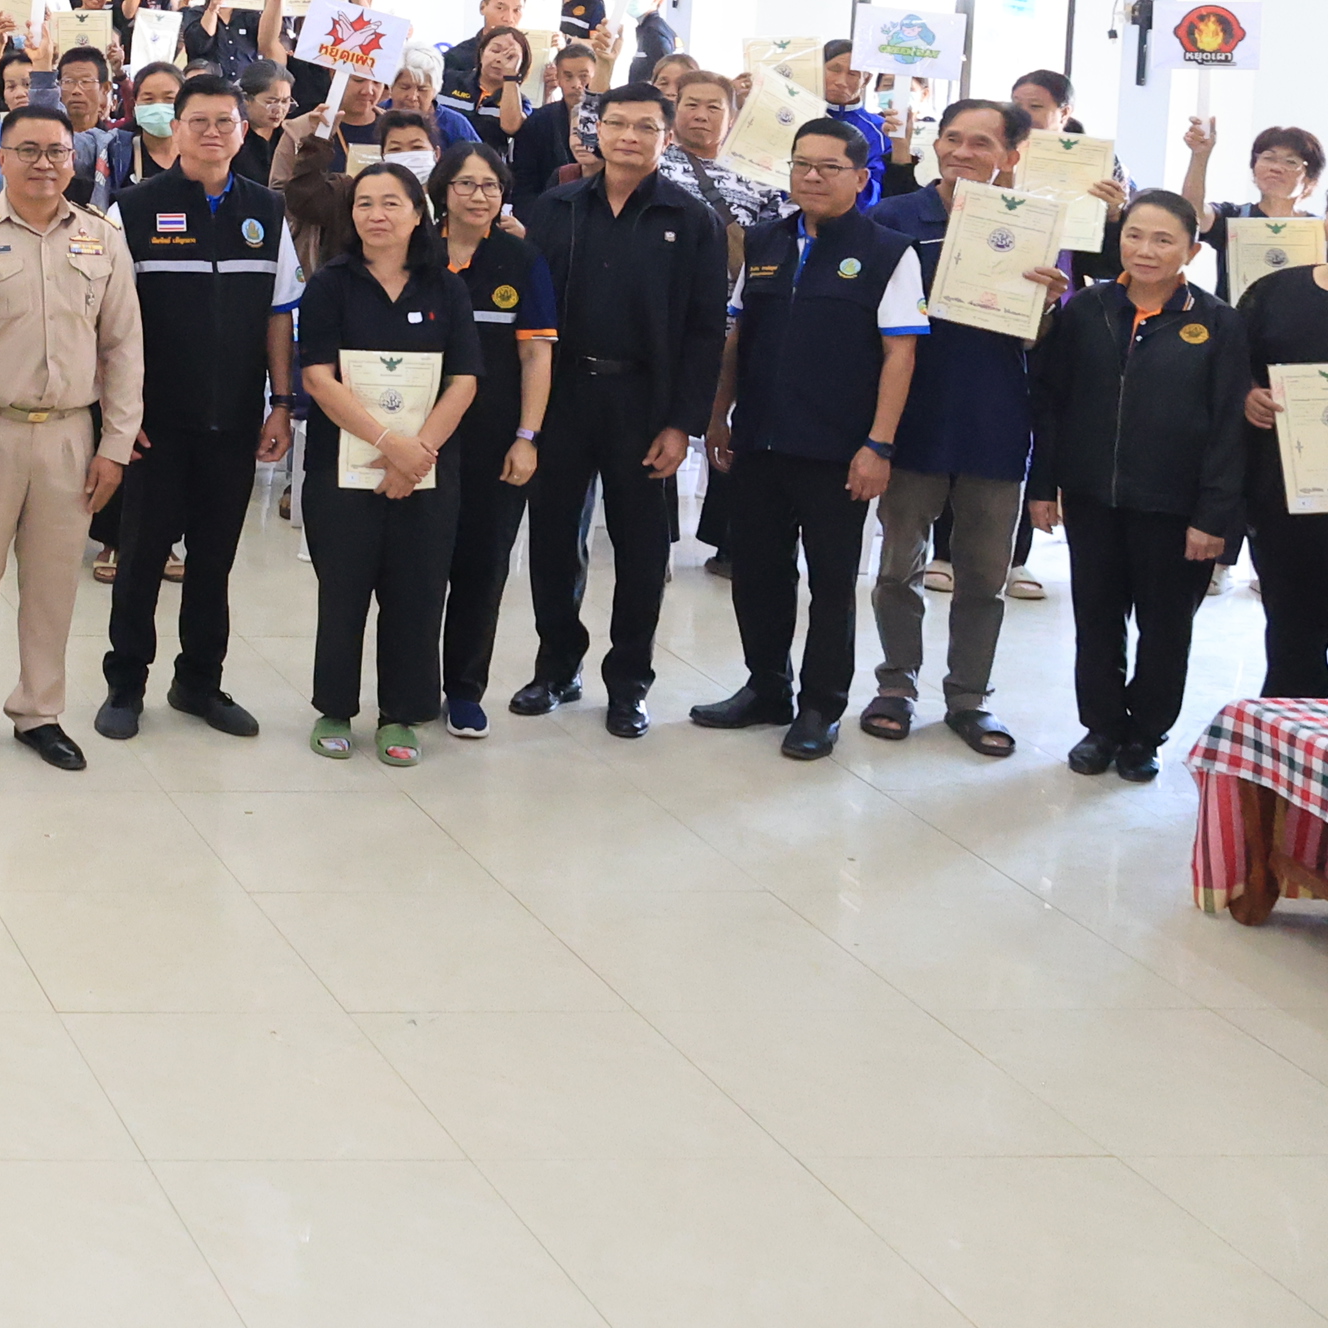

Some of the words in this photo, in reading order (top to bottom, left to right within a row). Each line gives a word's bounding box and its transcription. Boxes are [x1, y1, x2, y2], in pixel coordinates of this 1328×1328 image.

[319, 43, 377, 68] หยุดเผา
[1185, 52, 1232, 62] หยุดเผา
